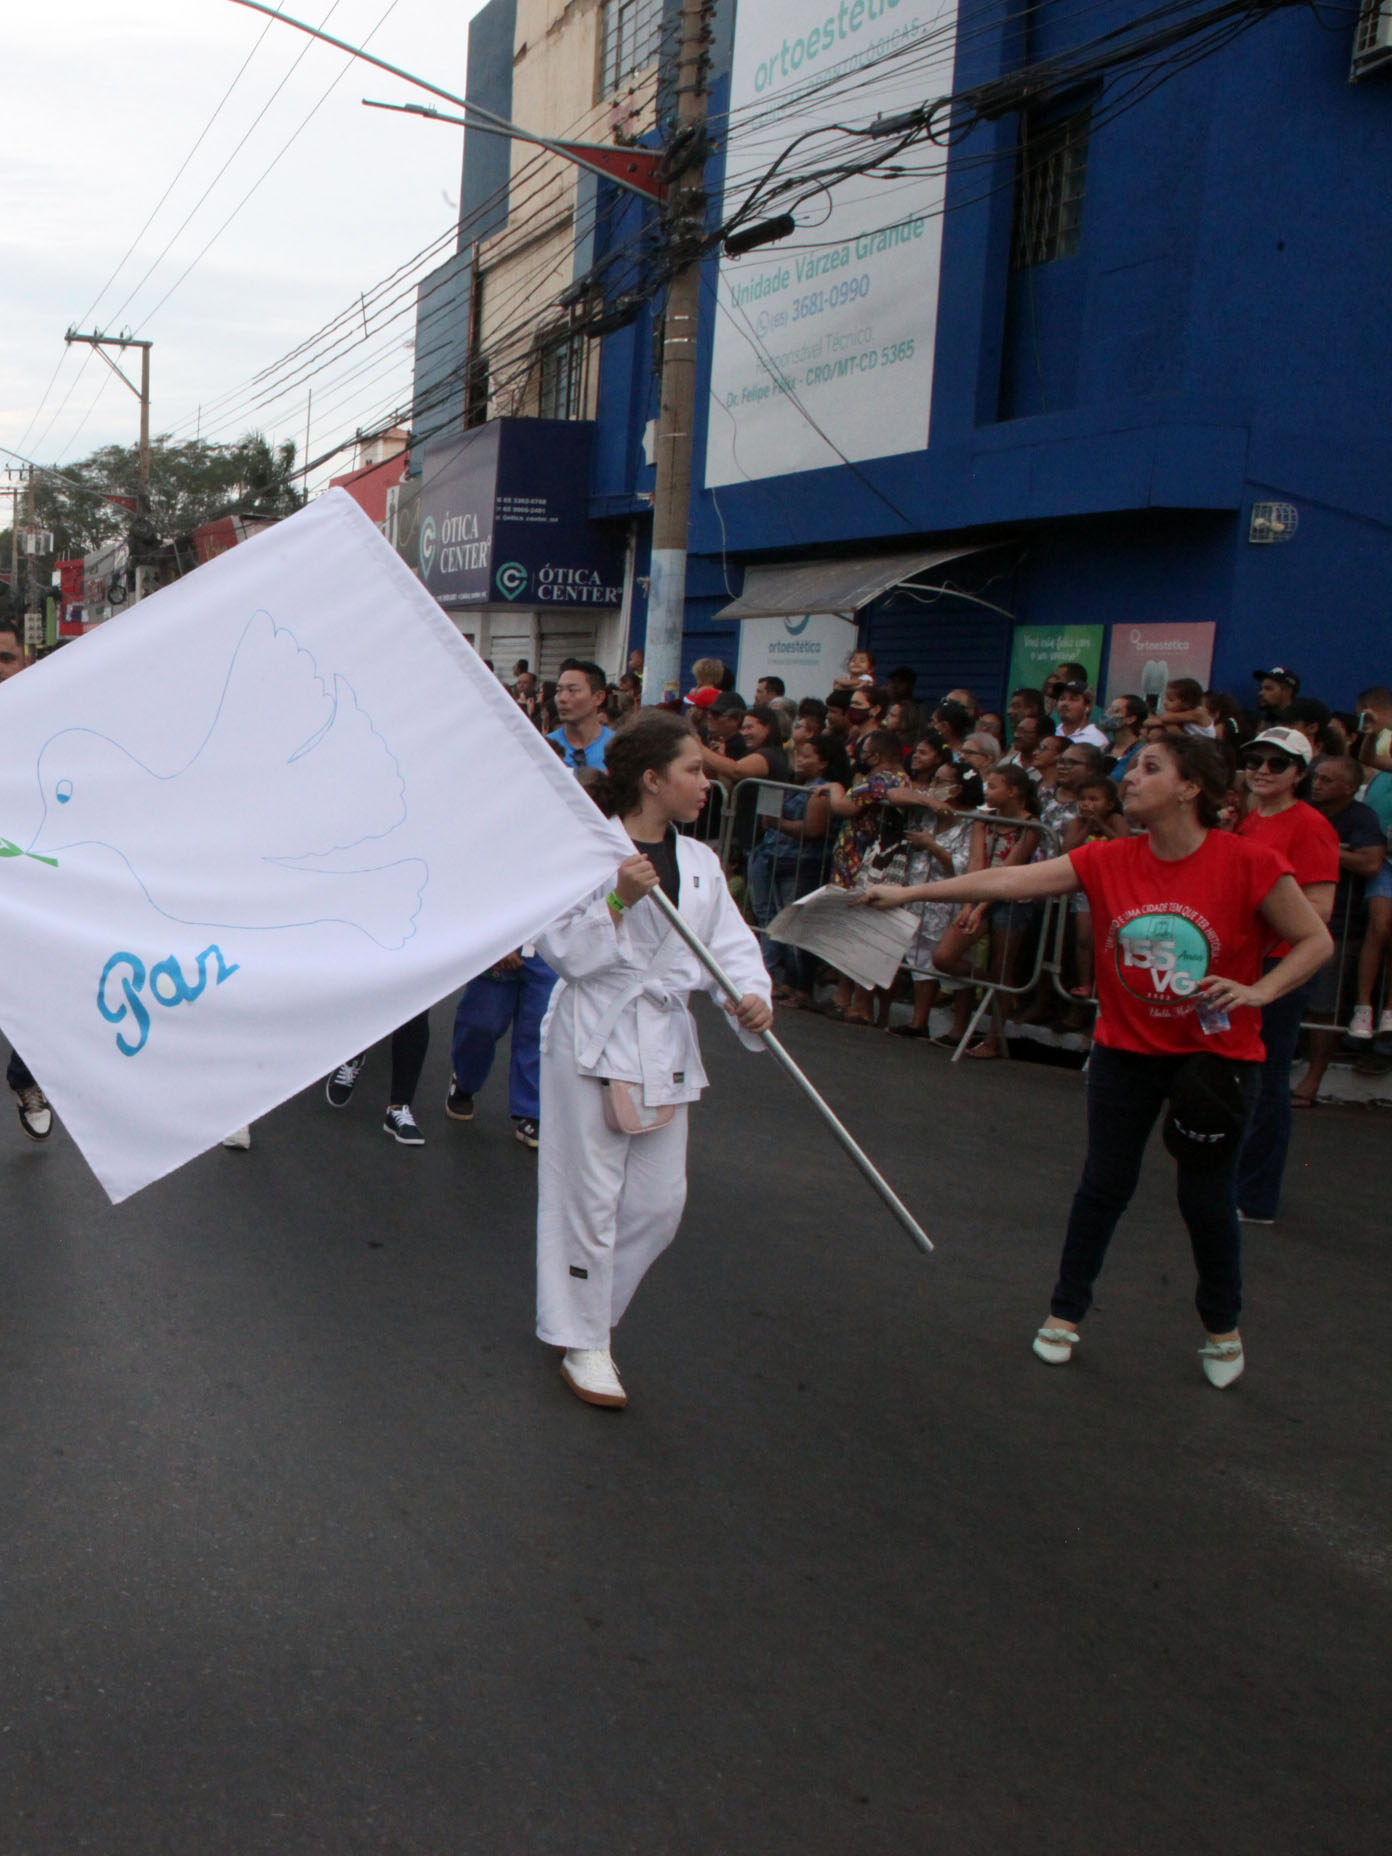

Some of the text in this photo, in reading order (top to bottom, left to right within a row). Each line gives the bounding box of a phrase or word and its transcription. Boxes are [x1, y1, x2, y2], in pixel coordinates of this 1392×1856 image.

[730, 213, 925, 309] Unidade Várzea Grande
[791, 273, 871, 322] 3681-0990
[880, 339, 916, 368] 5365
[441, 511, 479, 545] ÓTICA
[440, 541, 488, 574] CENTER
[538, 562, 601, 586] ÓTICA
[537, 584, 618, 603] CENTER
[769, 640, 822, 654] ortoestética
[1136, 639, 1190, 651] ortoestética
[1142, 902, 1168, 914] CIDADE
[1169, 902, 1183, 912] TEM
[1182, 906, 1199, 921] QUE
[1118, 938, 1176, 971] 155
[1150, 967, 1197, 996] VG
[97, 943, 240, 1057] Paz
